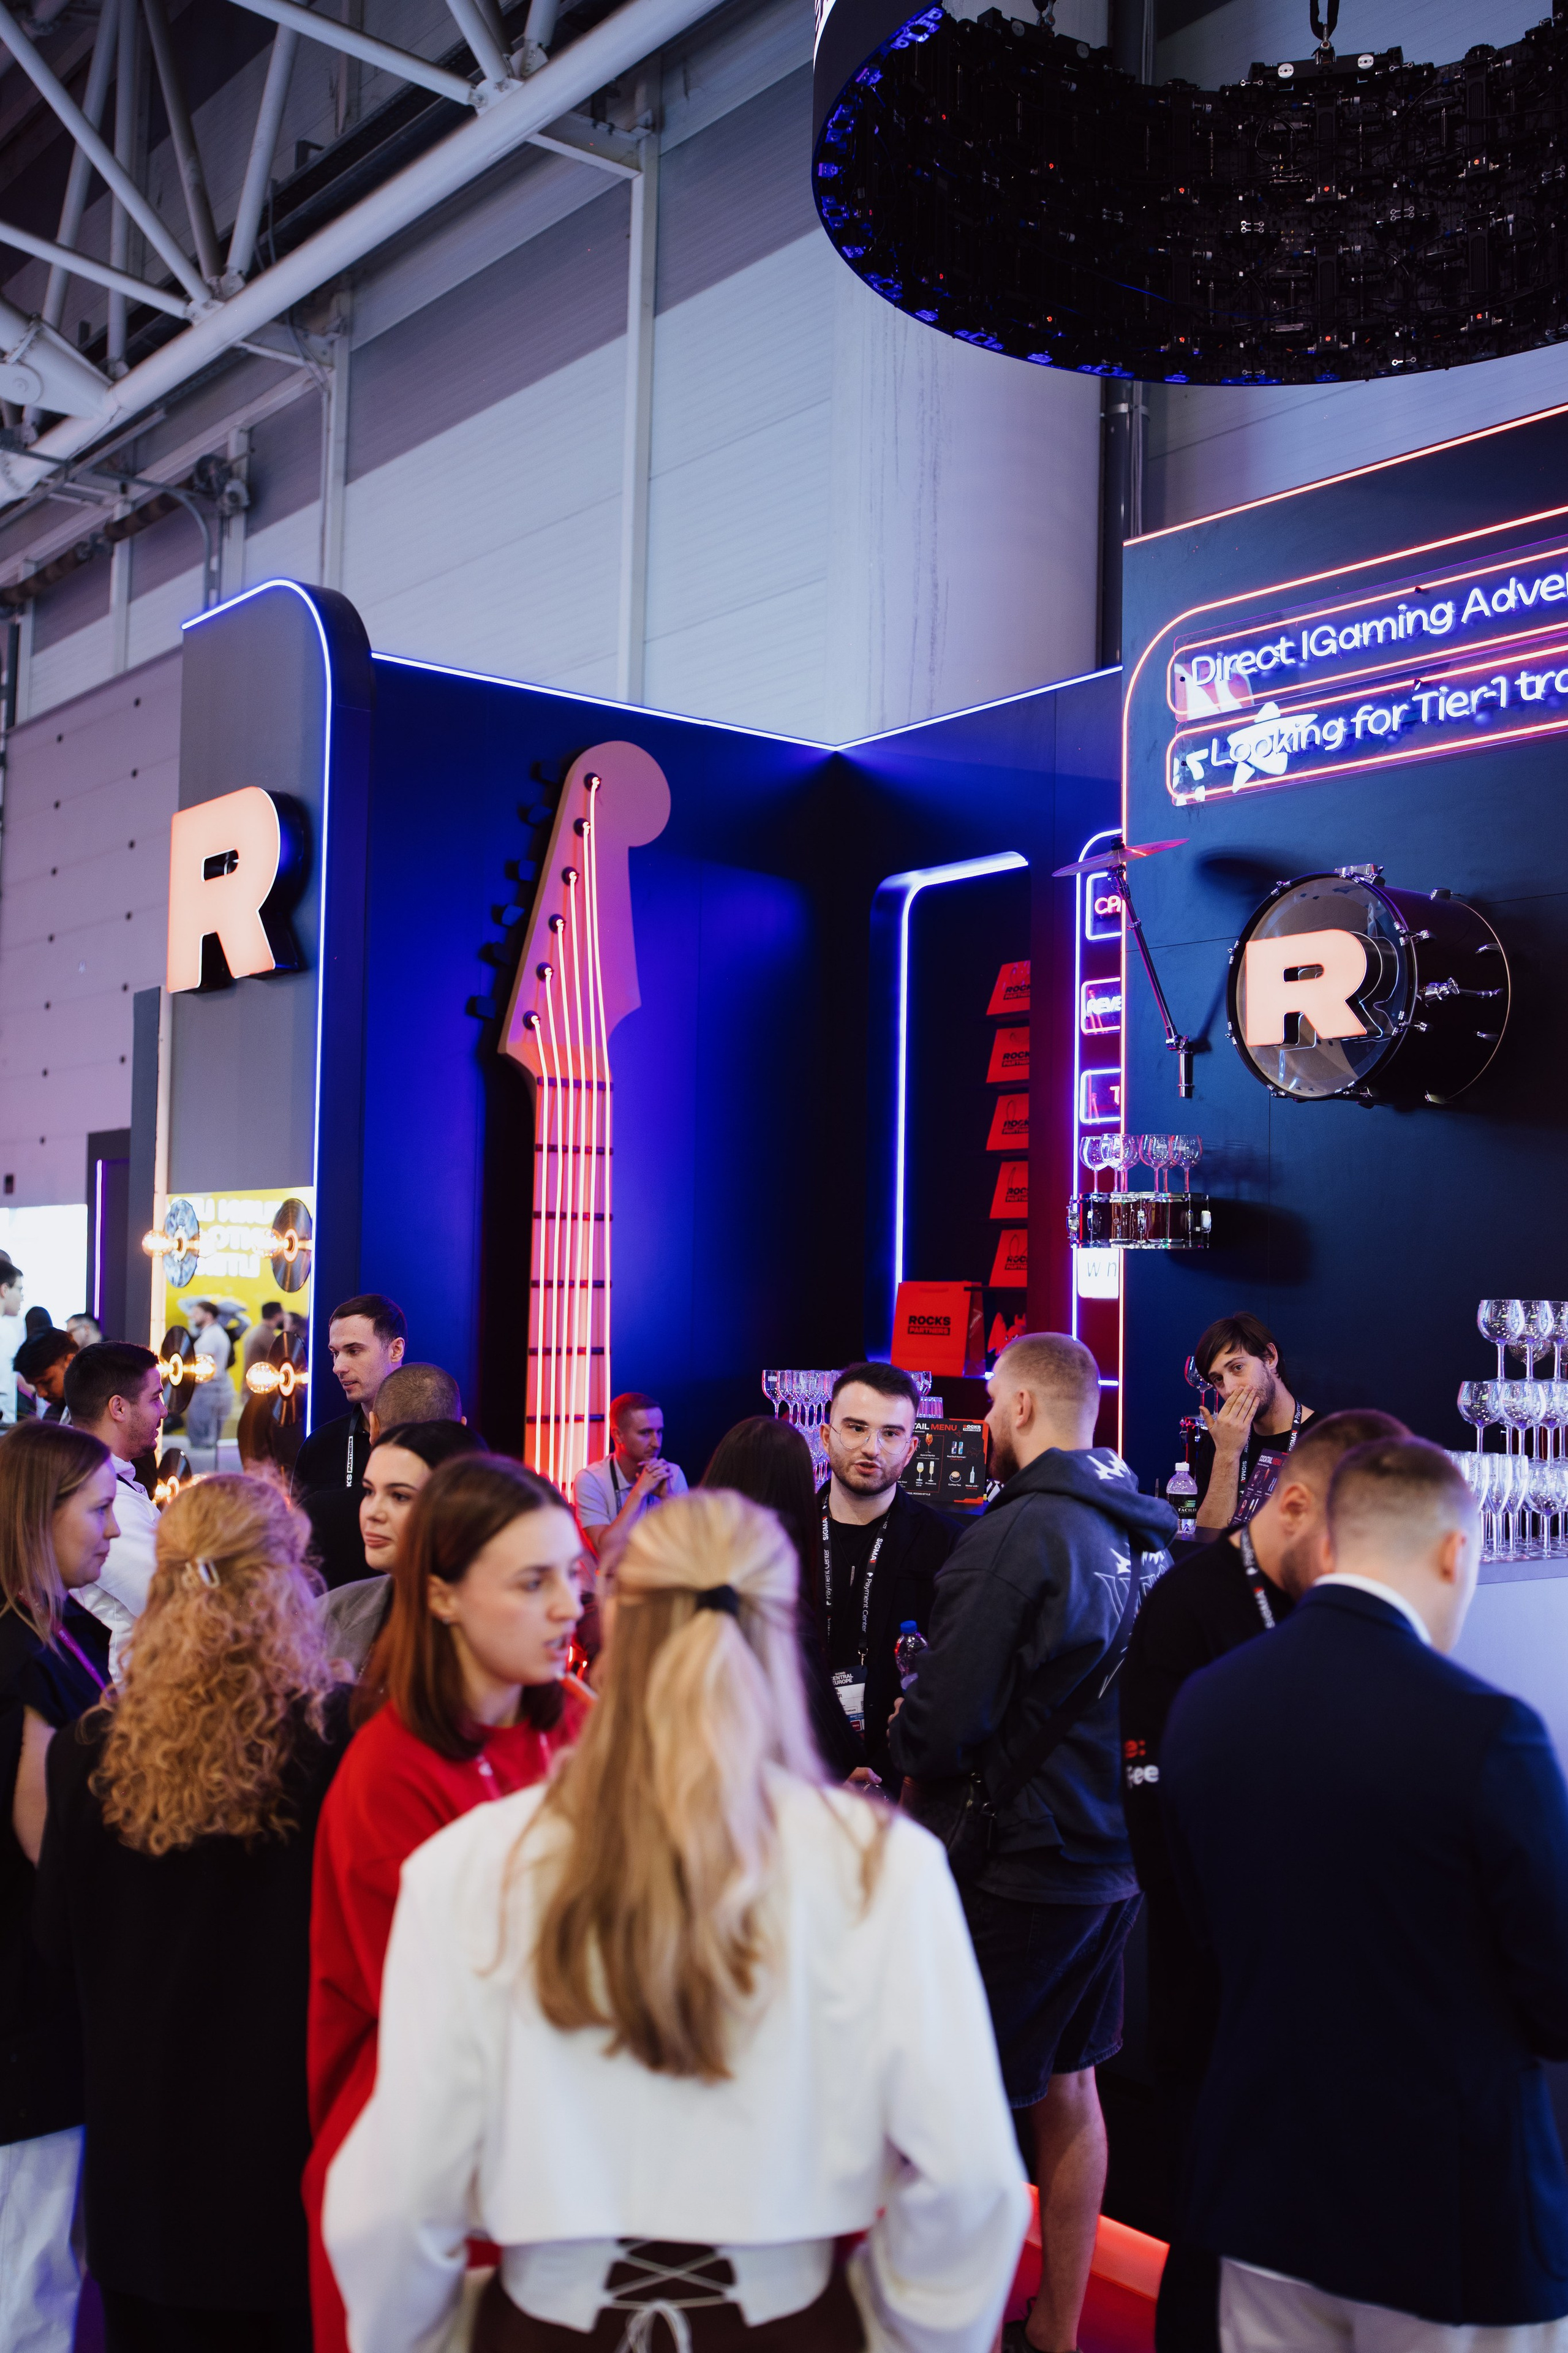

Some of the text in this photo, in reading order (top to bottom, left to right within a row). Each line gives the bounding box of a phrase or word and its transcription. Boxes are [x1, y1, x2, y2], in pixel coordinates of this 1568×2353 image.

[1191, 636, 1295, 687] Direct
[1461, 572, 1568, 624] Adve
[1210, 717, 1346, 766] Looking
[1351, 704, 1409, 739] for
[1412, 676, 1507, 724] Tier-1
[167, 786, 281, 994] R
[1246, 929, 1367, 1046] R
[1003, 1051, 1030, 1060] ROCK
[908, 1315, 951, 1326] ROCKS
[909, 1326, 949, 1335] PARTNERS
[870, 1538, 883, 1561] SiGMA
[863, 1579, 872, 1609] Payment
